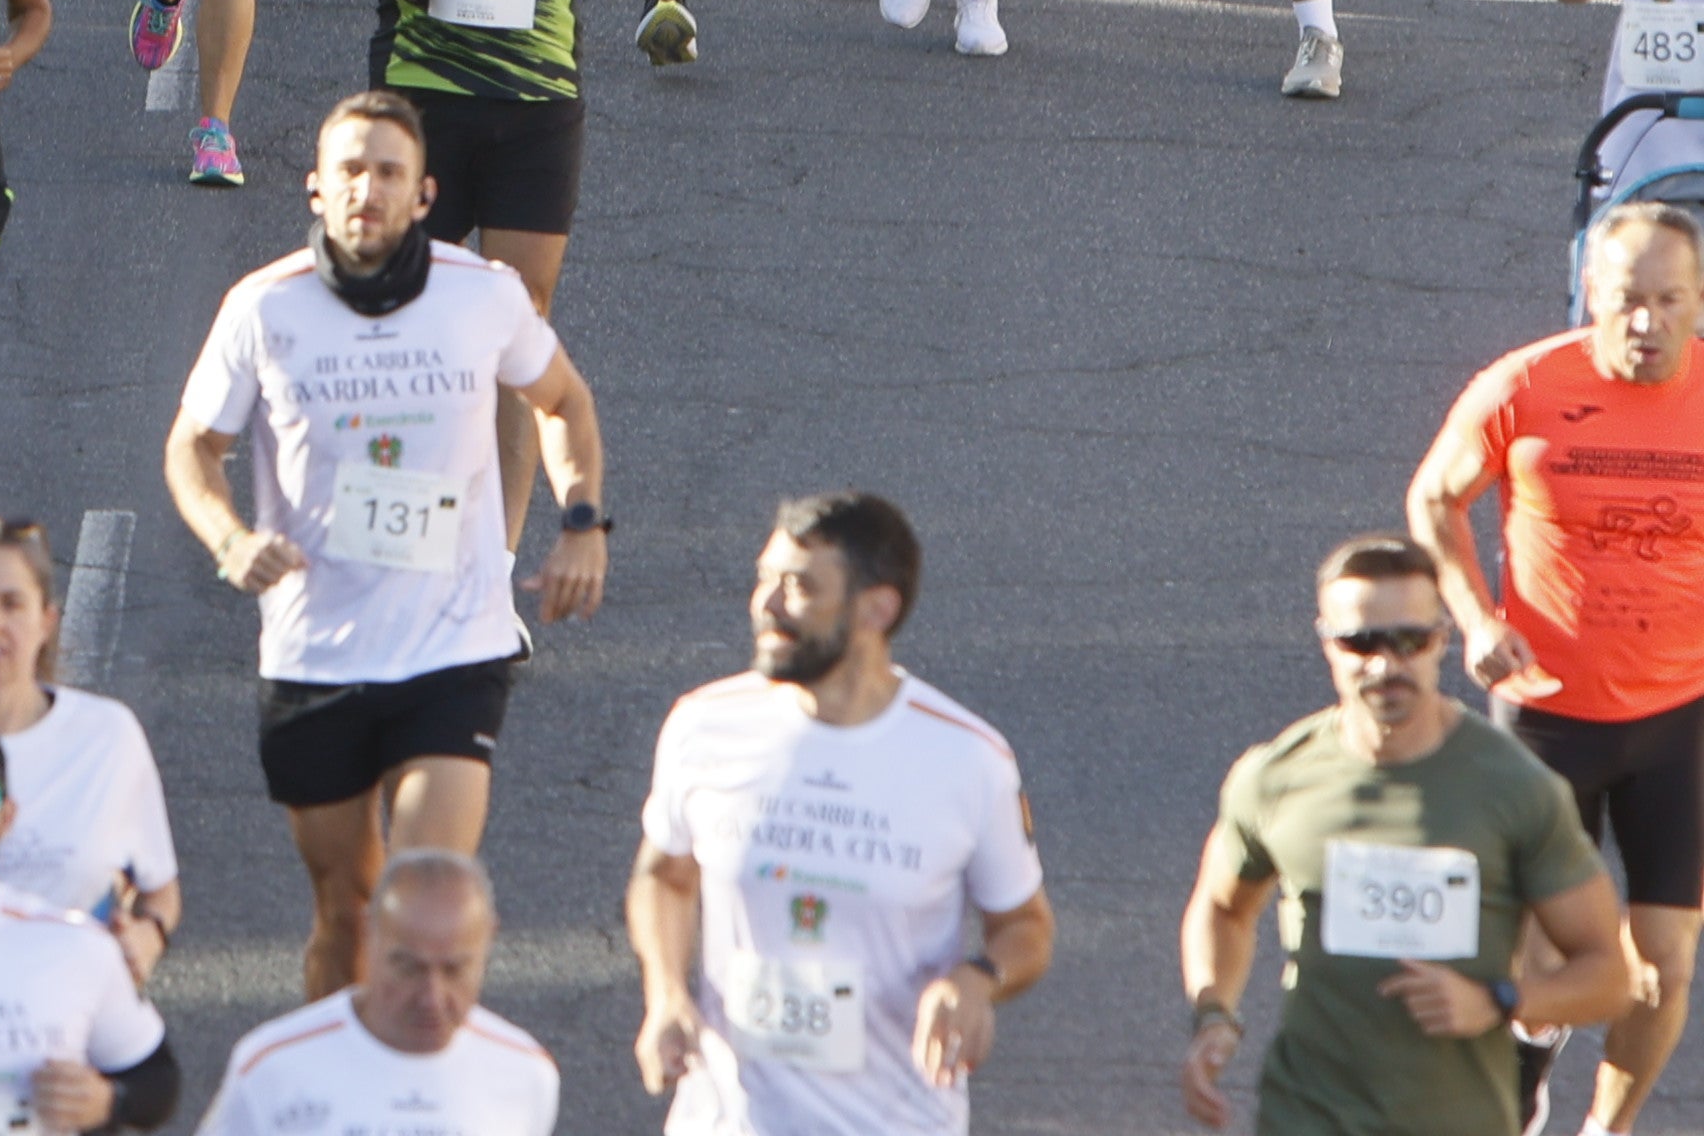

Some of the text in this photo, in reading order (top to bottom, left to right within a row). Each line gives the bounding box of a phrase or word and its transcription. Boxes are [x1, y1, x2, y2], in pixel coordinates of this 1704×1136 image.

[1634, 31, 1695, 62] 483
[315, 349, 444, 373] III CARRERA
[410, 371, 476, 395] CIVIL
[362, 497, 431, 537] 131
[1360, 881, 1446, 923] 390
[750, 993, 832, 1036] 238
